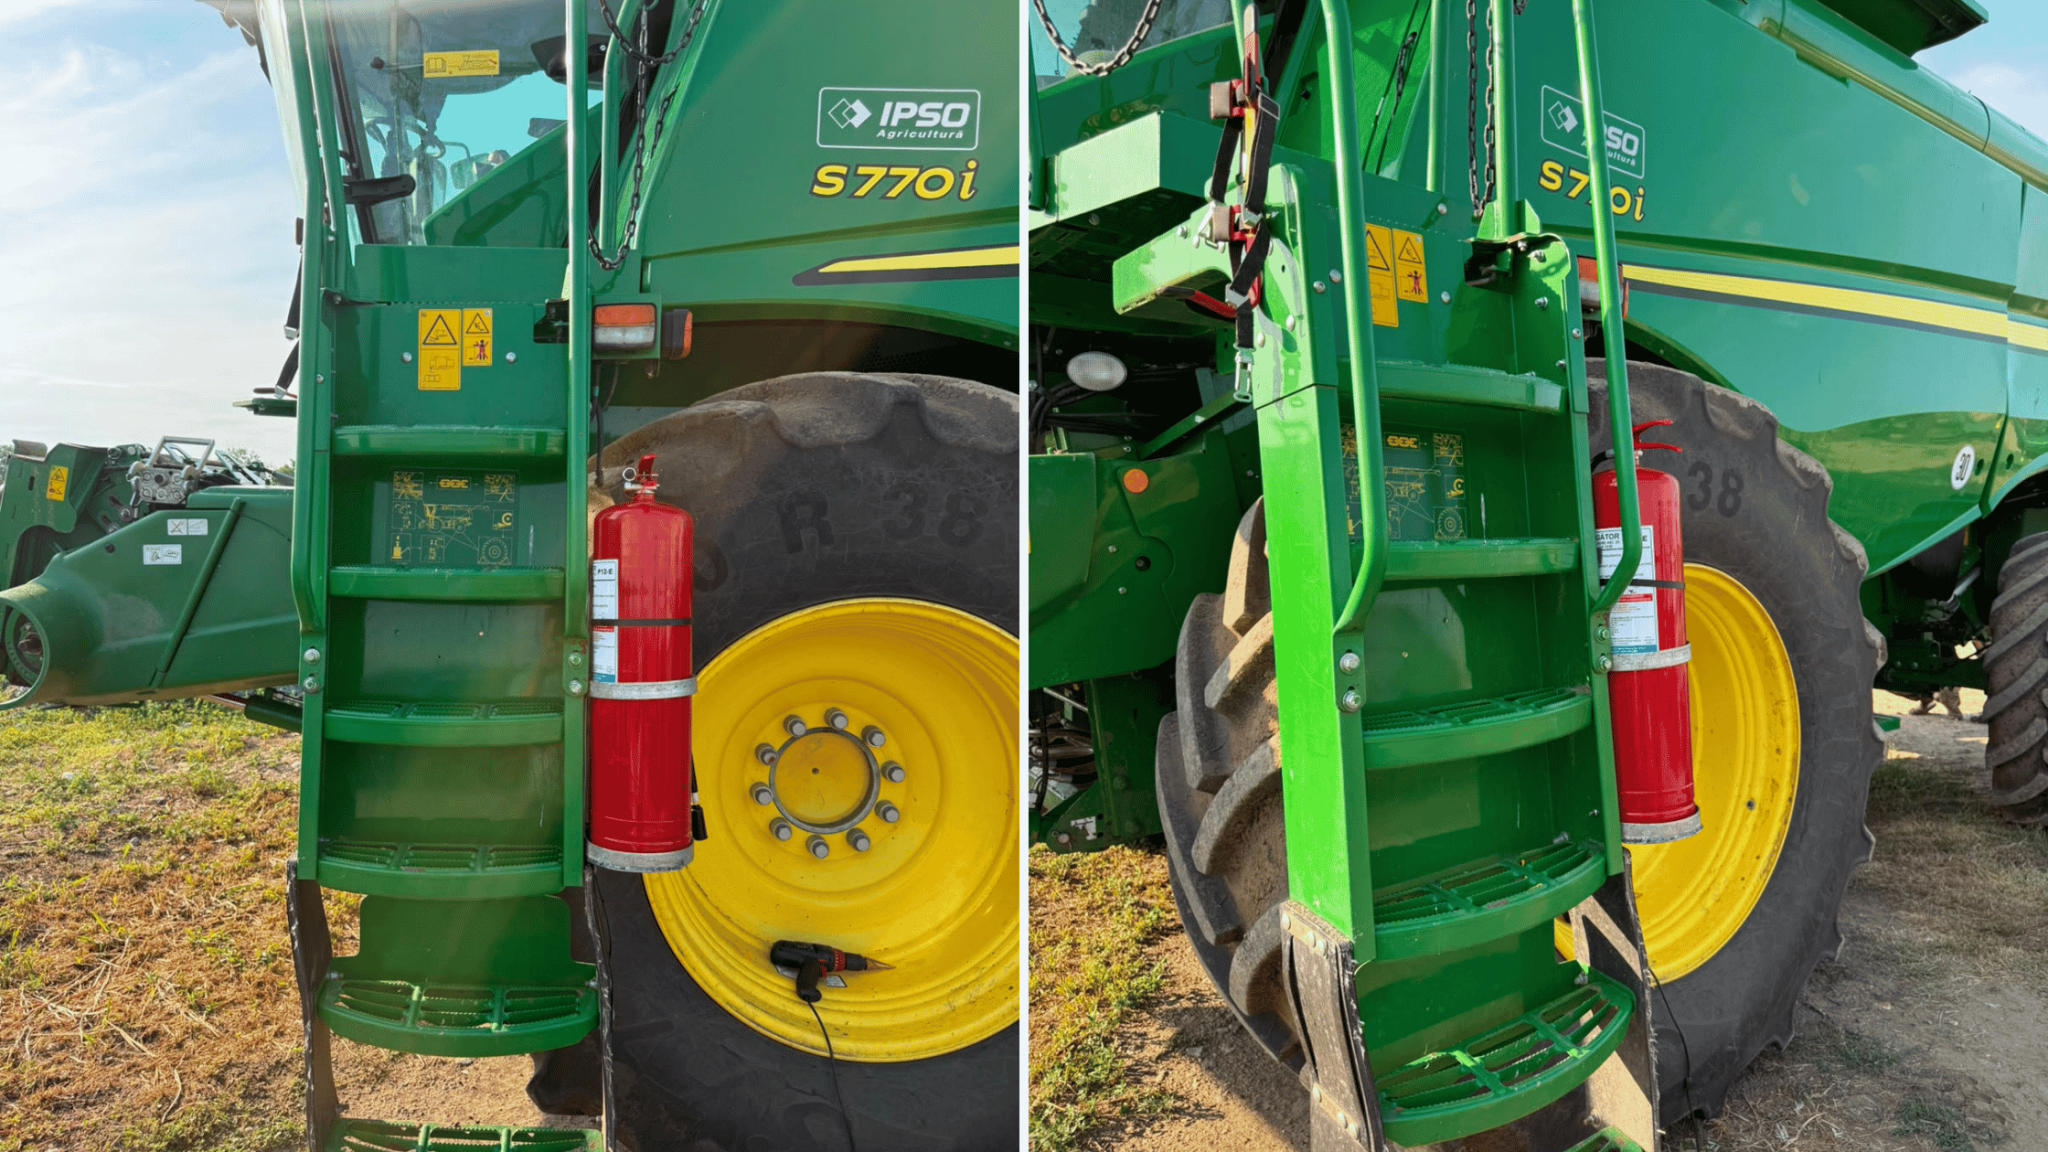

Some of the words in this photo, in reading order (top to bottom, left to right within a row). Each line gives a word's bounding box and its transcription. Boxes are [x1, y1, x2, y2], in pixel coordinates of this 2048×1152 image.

[876, 129, 964, 140] Agricultură
[879, 101, 971, 128] IPSO
[810, 158, 978, 201] S770i
[1538, 157, 1645, 222] S70i
[1955, 453, 1971, 481] 30
[1686, 461, 1744, 517] 38
[777, 490, 834, 553] R
[882, 481, 989, 547] 38
